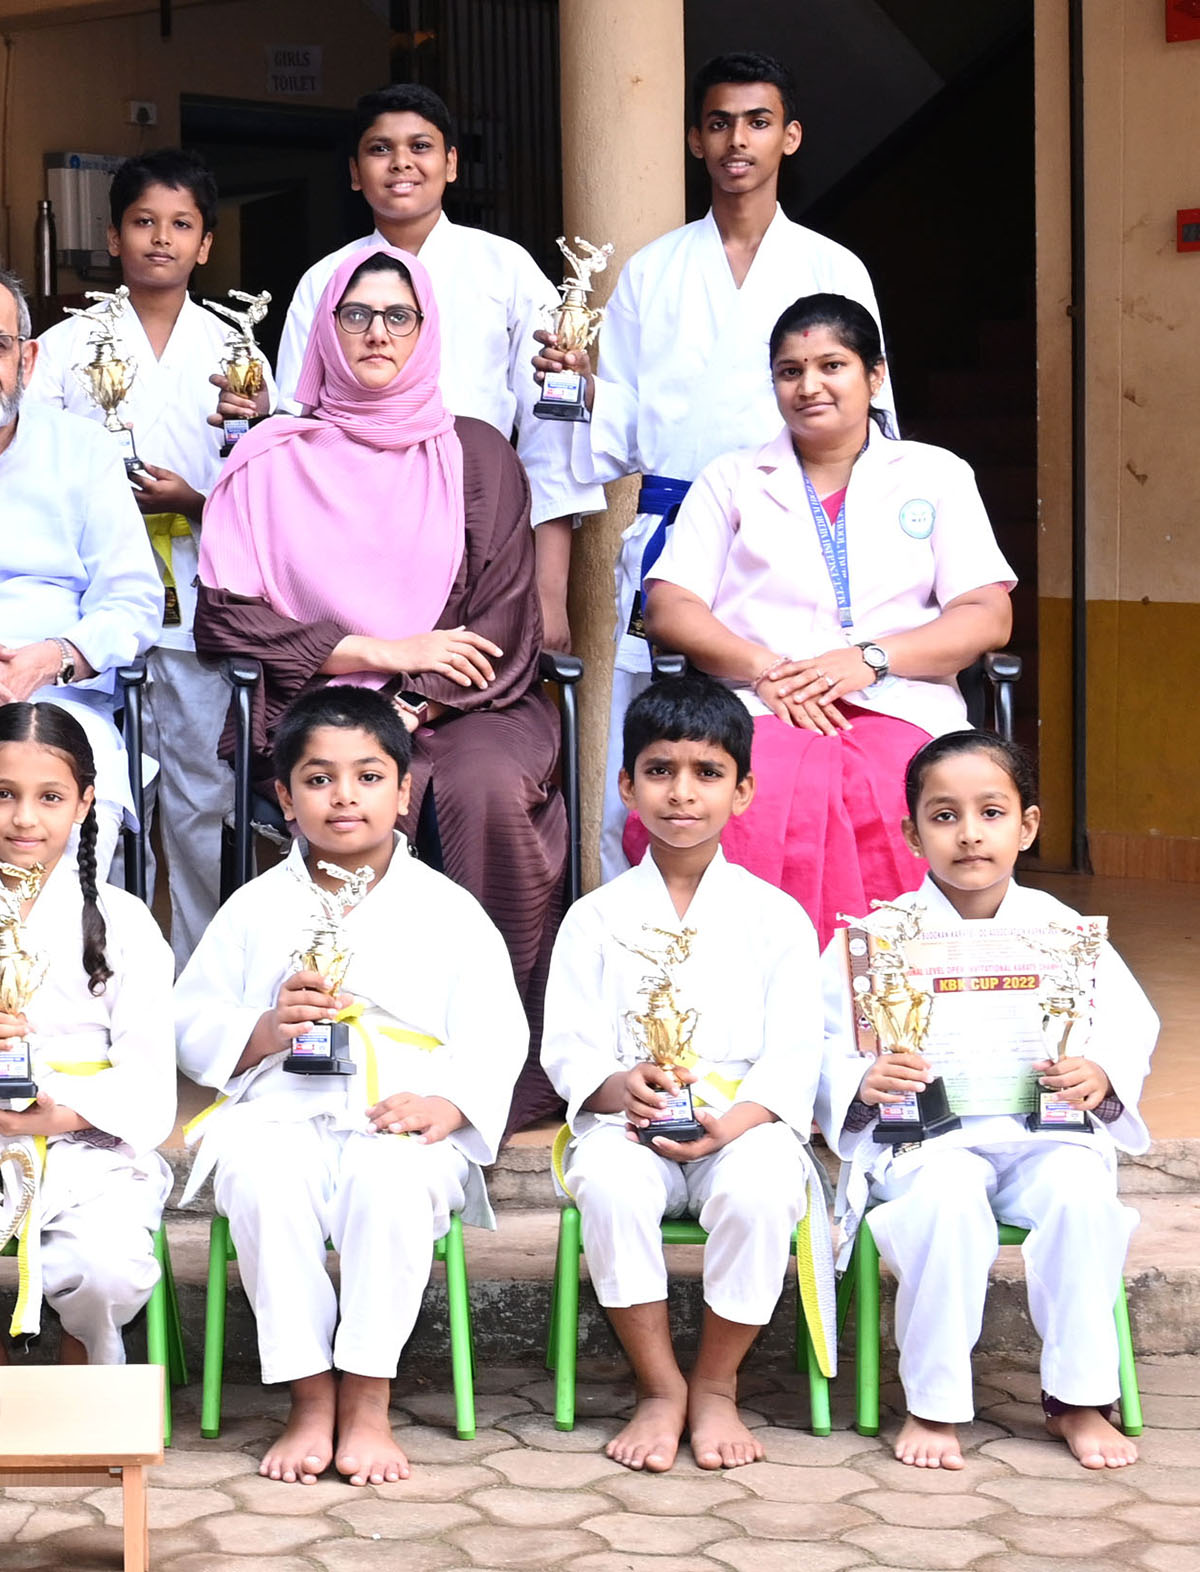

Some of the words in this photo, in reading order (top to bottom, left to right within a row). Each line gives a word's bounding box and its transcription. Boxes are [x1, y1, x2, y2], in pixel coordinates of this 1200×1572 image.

[274, 51, 311, 66] GIRLS
[271, 75, 316, 91] TOILET
[939, 979, 967, 991] KBK
[971, 977, 999, 990] CUP
[1003, 976, 1036, 989] 2022
